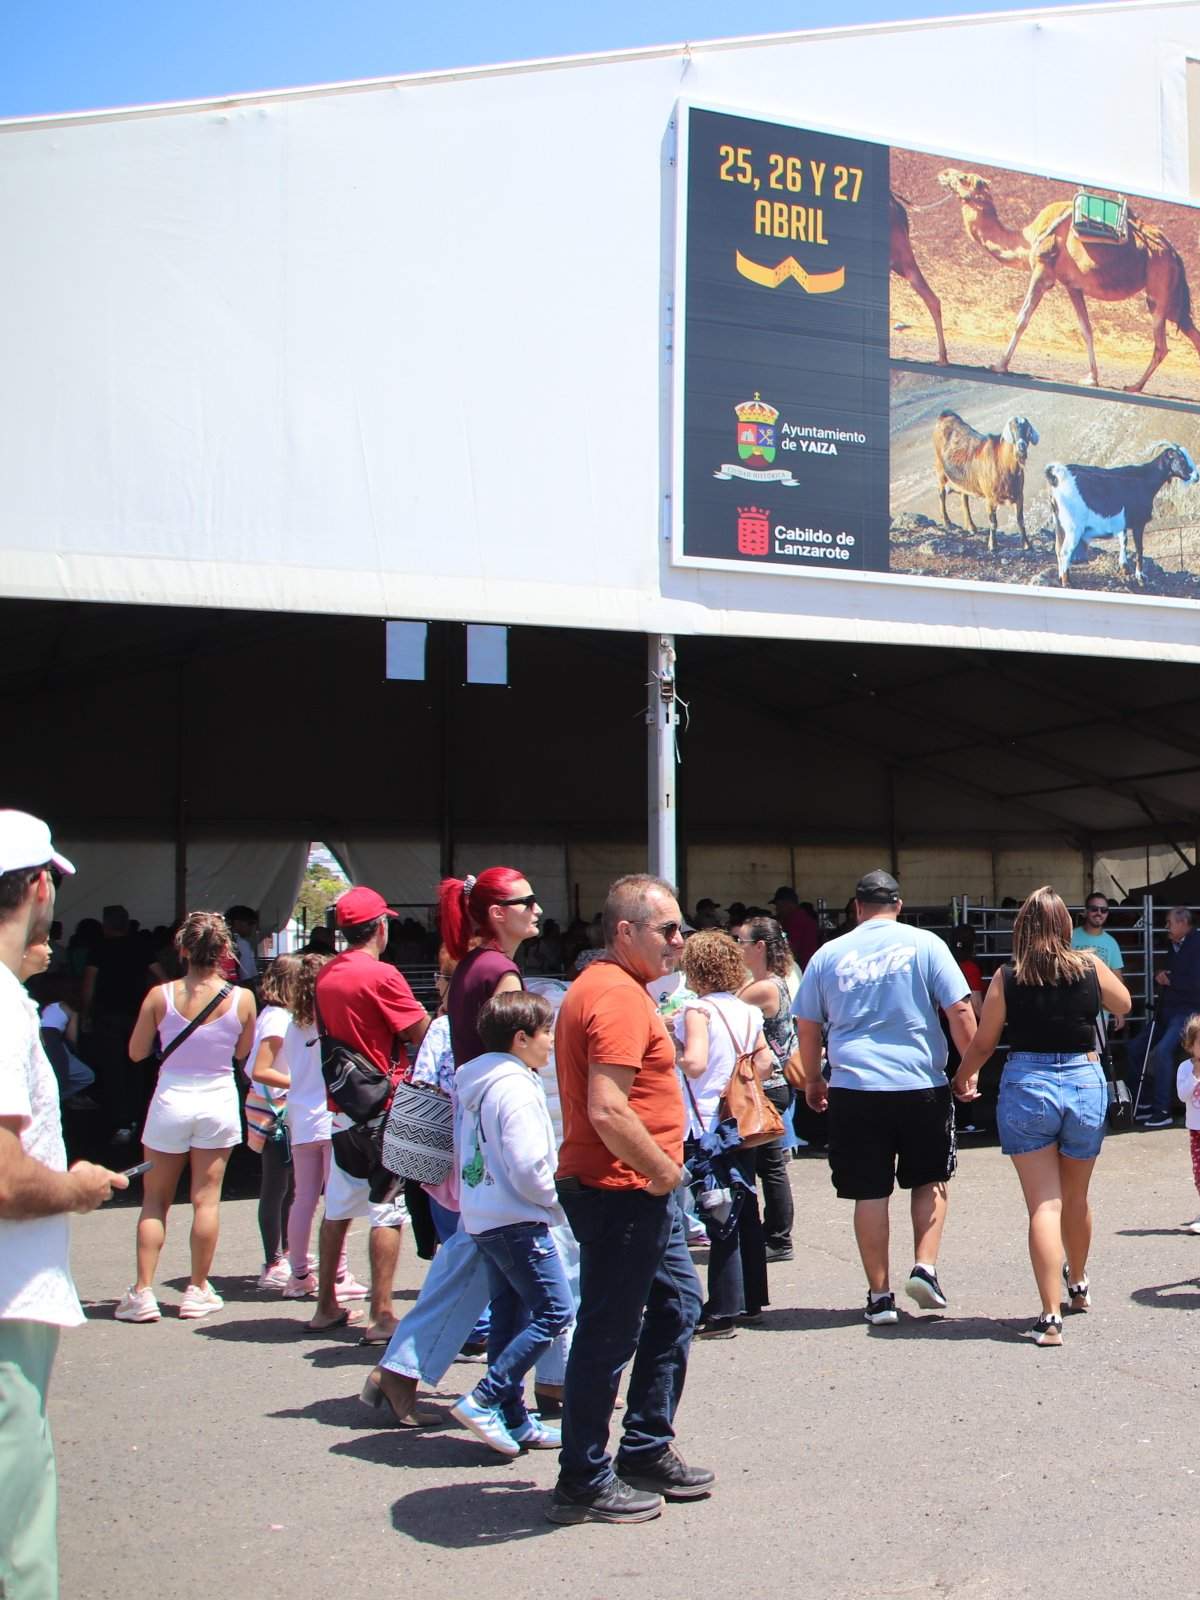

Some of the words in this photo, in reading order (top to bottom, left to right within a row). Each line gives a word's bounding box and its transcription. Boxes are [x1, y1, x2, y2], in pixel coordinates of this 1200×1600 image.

[719, 145, 761, 191] 25,
[769, 154, 802, 192] 26
[810, 160, 826, 196] Y
[833, 165, 863, 202] 27
[755, 199, 829, 245] ABRIL
[781, 423, 866, 443] Ayuntamiento
[781, 439, 797, 451] de
[800, 440, 838, 455] YAIZA
[774, 525, 832, 544] Cabildo
[836, 532, 855, 546] de
[774, 541, 850, 560] Lanzarote
